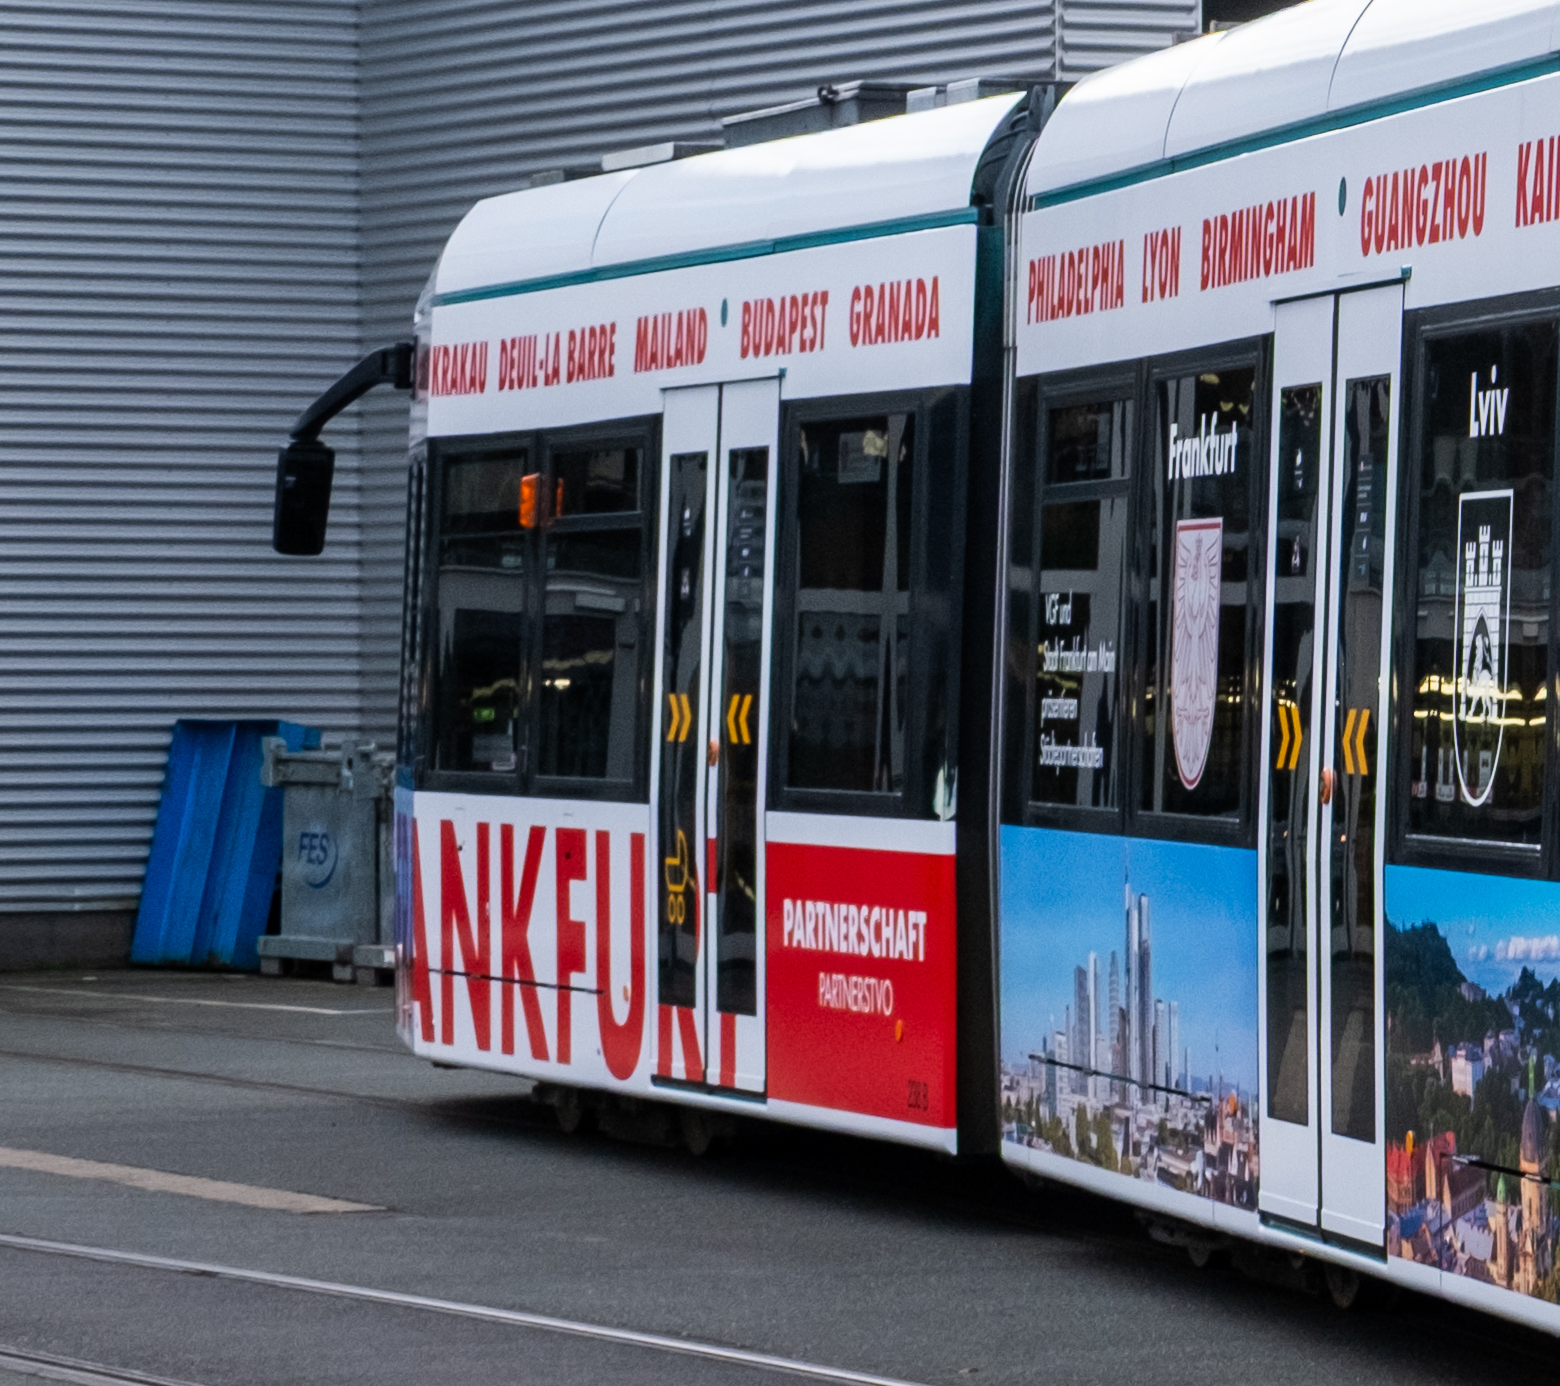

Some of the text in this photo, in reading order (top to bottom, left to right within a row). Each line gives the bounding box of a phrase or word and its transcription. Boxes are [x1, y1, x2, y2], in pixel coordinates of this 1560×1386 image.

[1028, 240, 1124, 324] PHILADELPHIA
[1142, 226, 1181, 303] LYON
[1200, 192, 1316, 291] BIRMINGHAM
[1361, 153, 1487, 256] GUANGZHOU
[431, 276, 940, 396] KRAKAU DEUIL-LA BARRE MAILAND BUDAPEST GRANADA
[1470, 365, 1509, 437] Lviv
[1168, 411, 1237, 480] Frankfurt
[297, 831, 330, 865] FES
[412, 818, 737, 1088] ANKFU
[783, 898, 927, 962] PARTNERSCHAFT
[818, 972, 893, 1016] PARTNERSTVO
